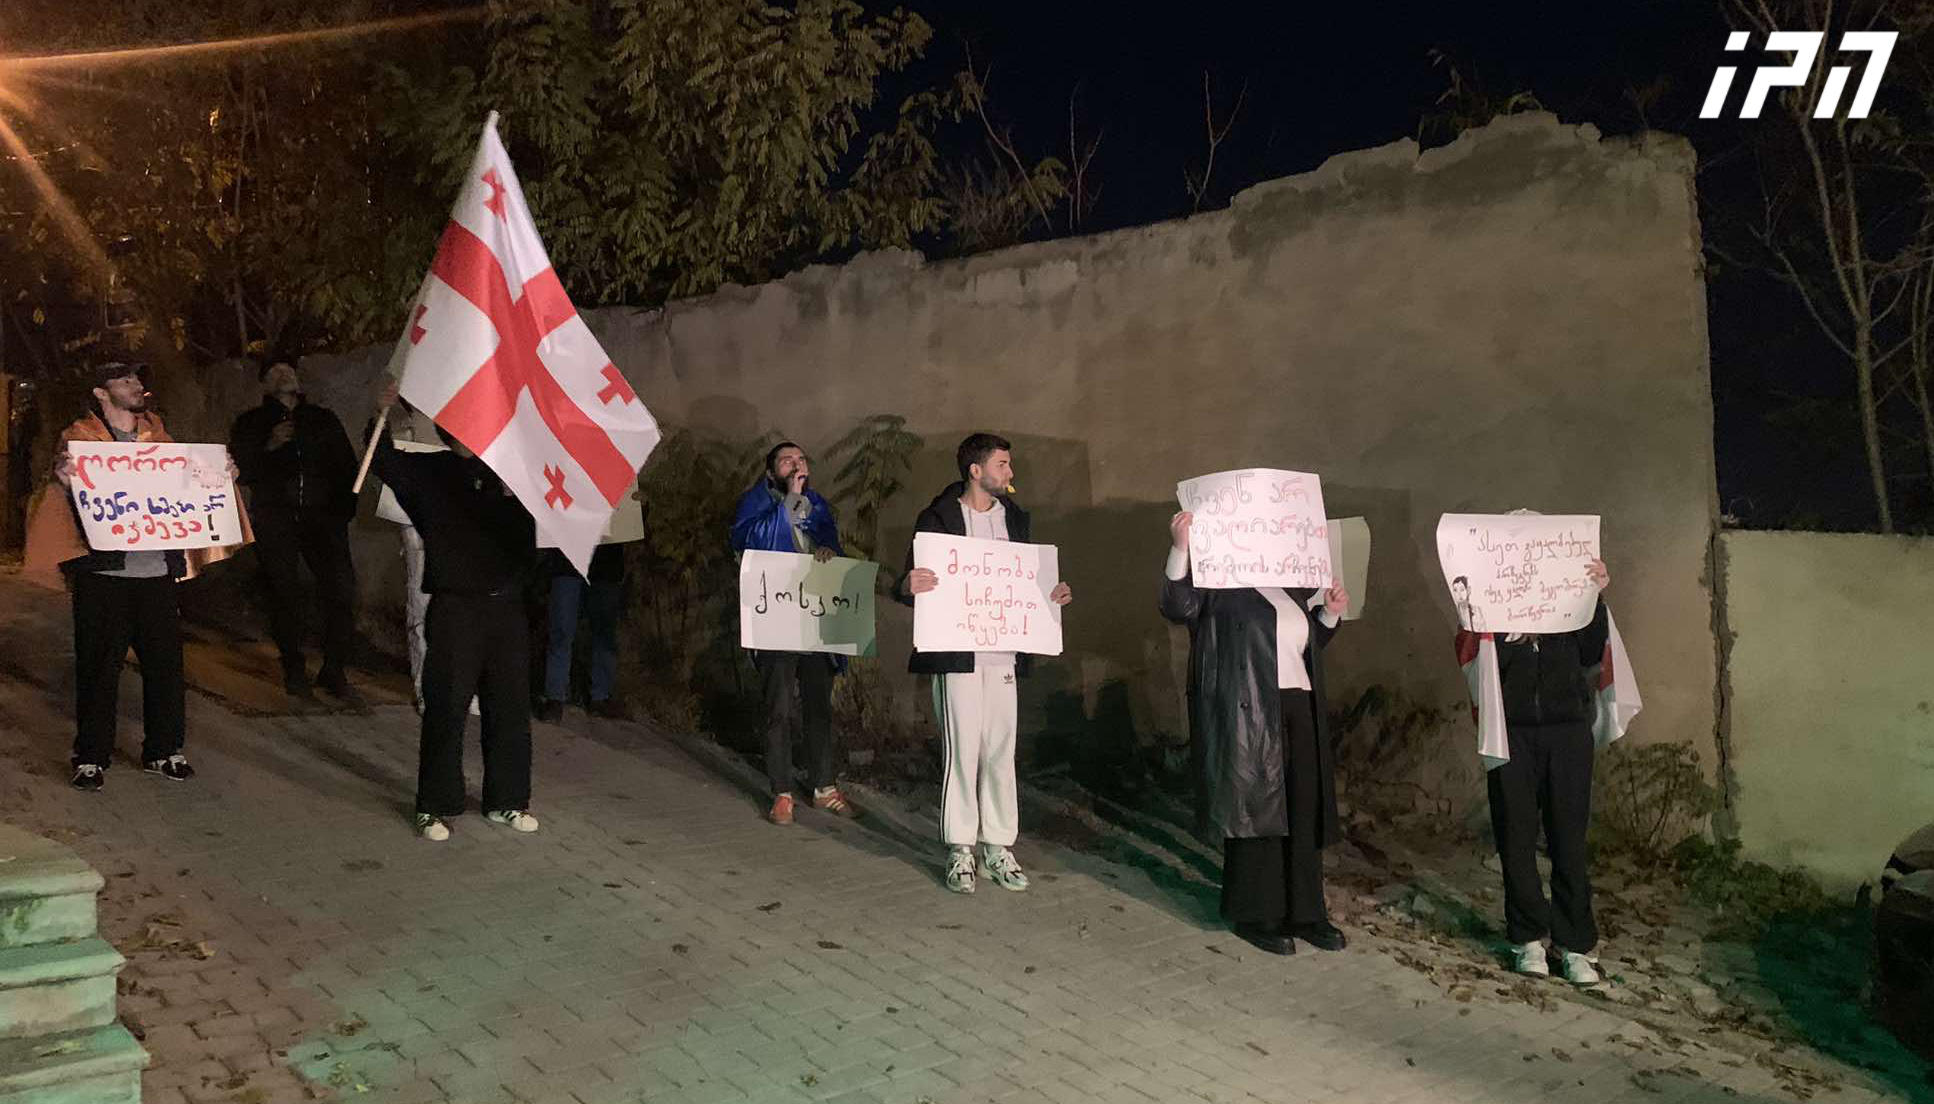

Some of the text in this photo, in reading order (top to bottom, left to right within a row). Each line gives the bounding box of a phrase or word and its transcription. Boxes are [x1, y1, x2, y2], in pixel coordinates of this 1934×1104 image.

[76, 444, 188, 489] ღორო
[79, 490, 226, 521] ჩვენი ხმები არ
[947, 548, 1035, 580] მონობა
[964, 581, 1037, 620] სიჩუმით
[956, 612, 1028, 646] იწყება!
